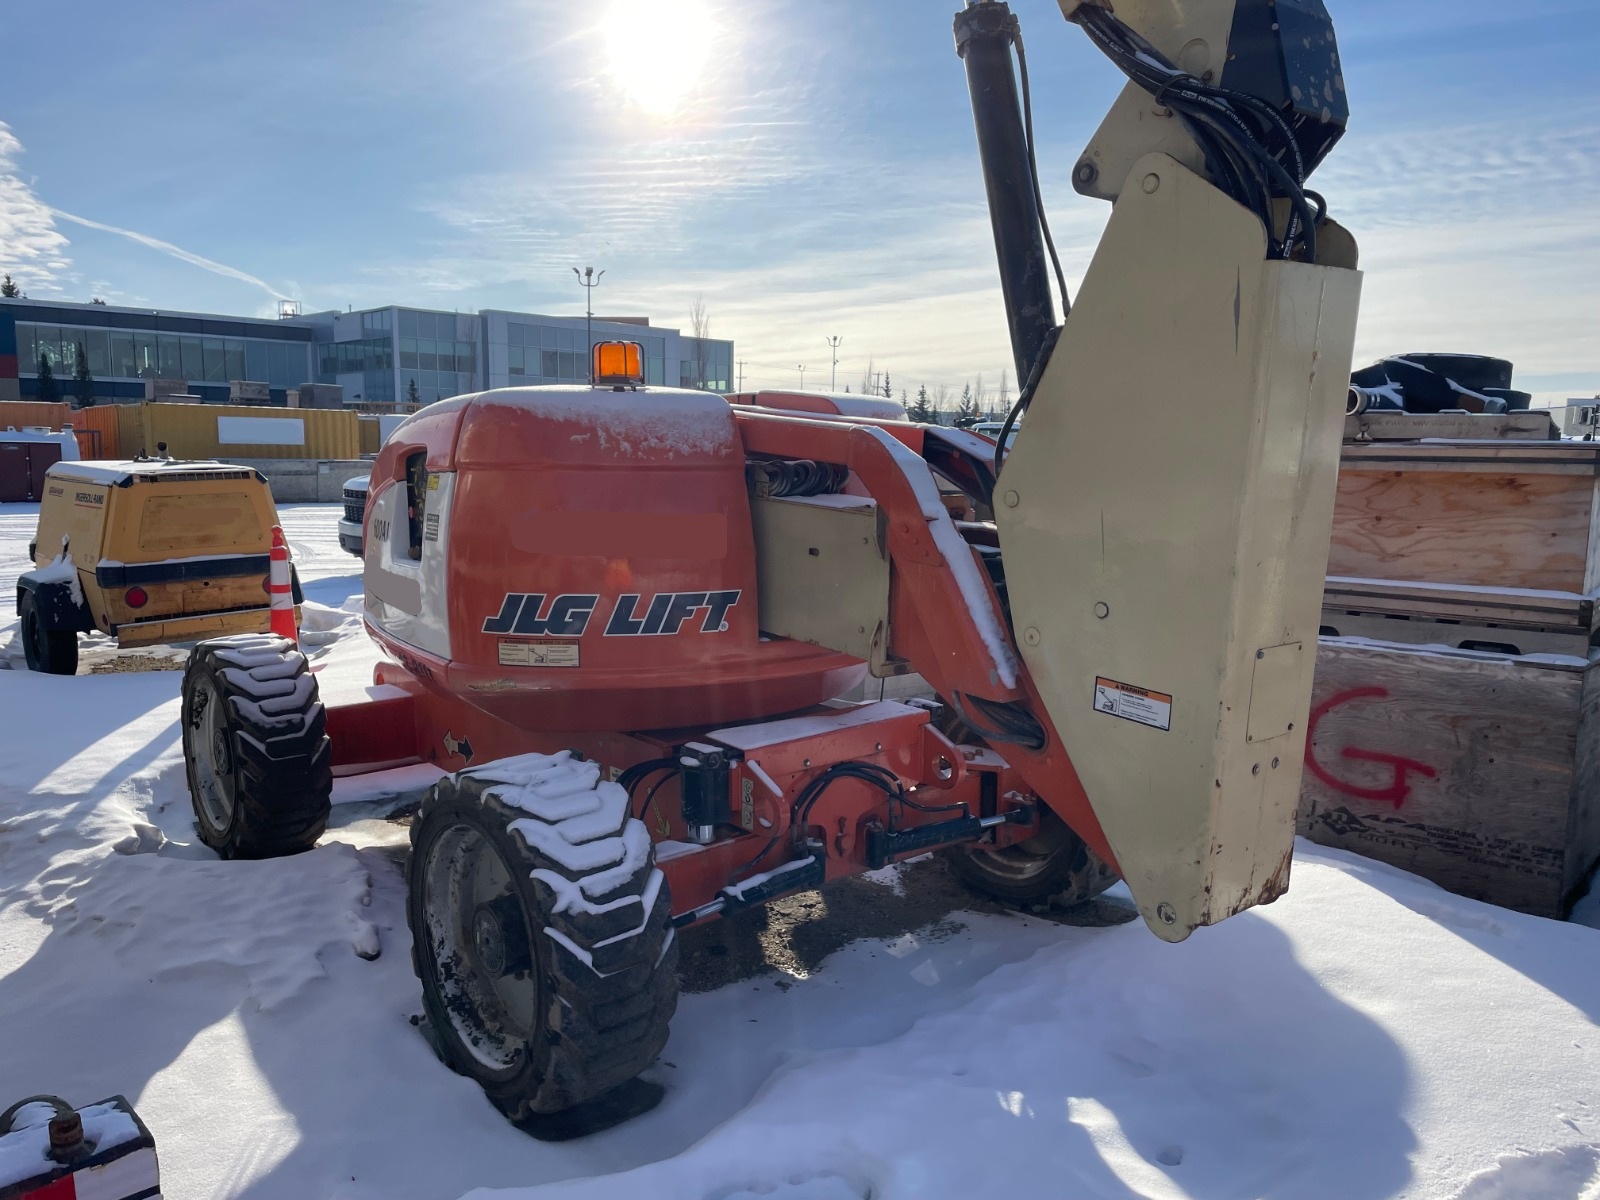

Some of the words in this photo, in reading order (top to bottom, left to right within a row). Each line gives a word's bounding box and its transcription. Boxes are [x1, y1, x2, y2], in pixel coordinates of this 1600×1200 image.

[481, 592, 600, 636] JLG
[1120, 684, 1149, 697] WARNING
[1304, 686, 1436, 810] G
